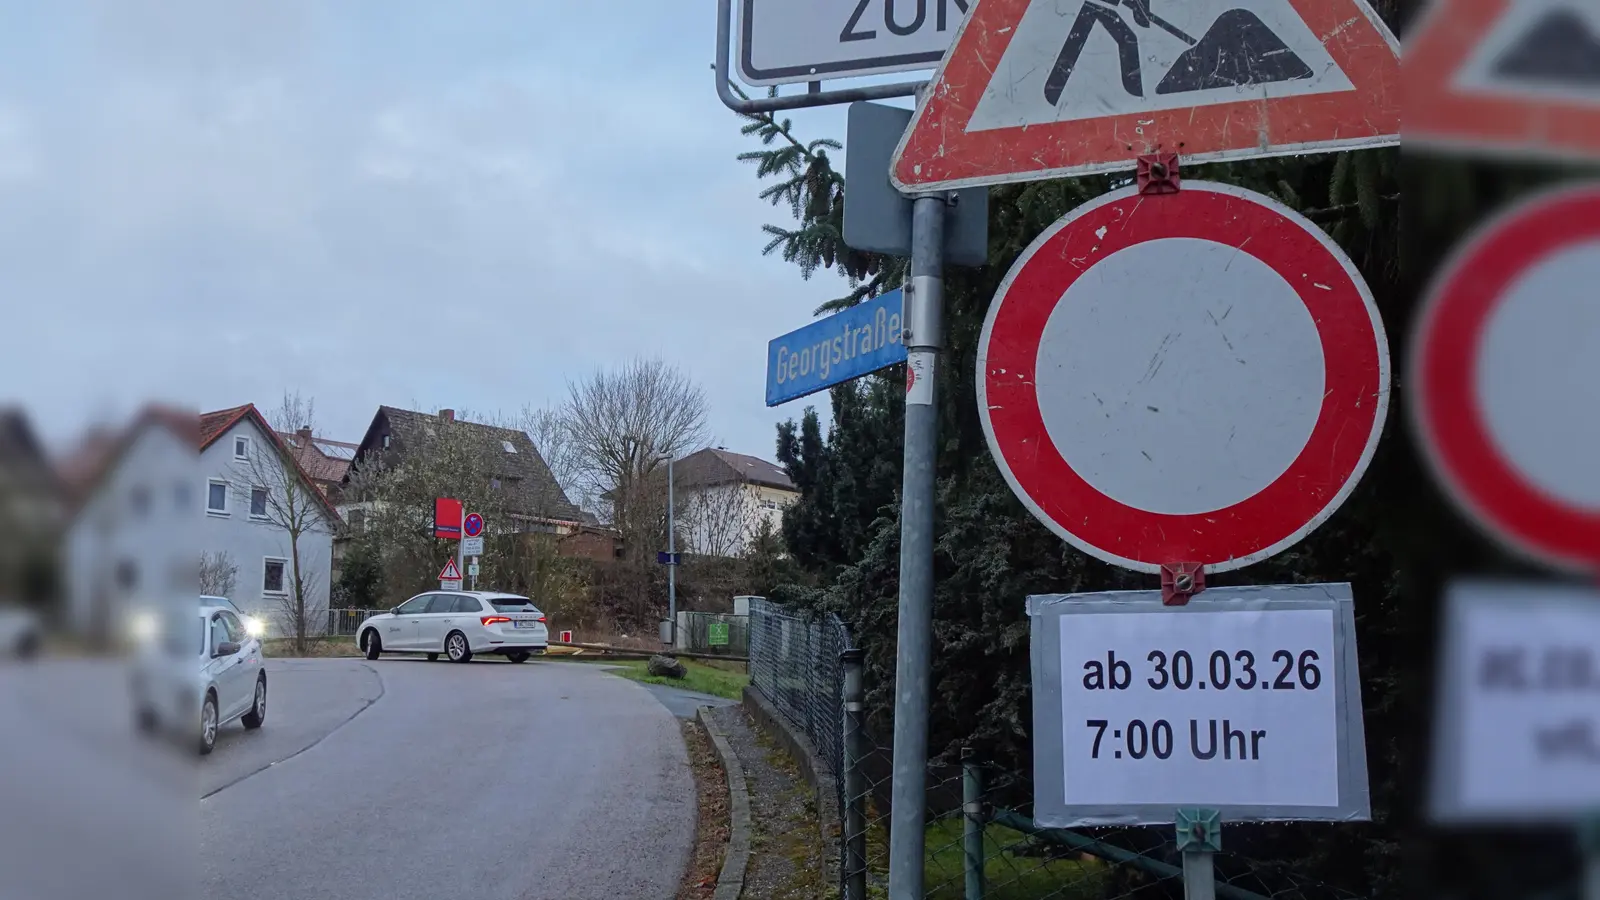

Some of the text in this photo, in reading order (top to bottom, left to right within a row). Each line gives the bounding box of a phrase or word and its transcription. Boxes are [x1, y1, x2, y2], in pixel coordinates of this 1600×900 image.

[776, 306, 901, 386] Georgstraße
[1082, 649, 1322, 690] ab 30.03.26
[1086, 719, 1267, 760] 7:00 Uhr
